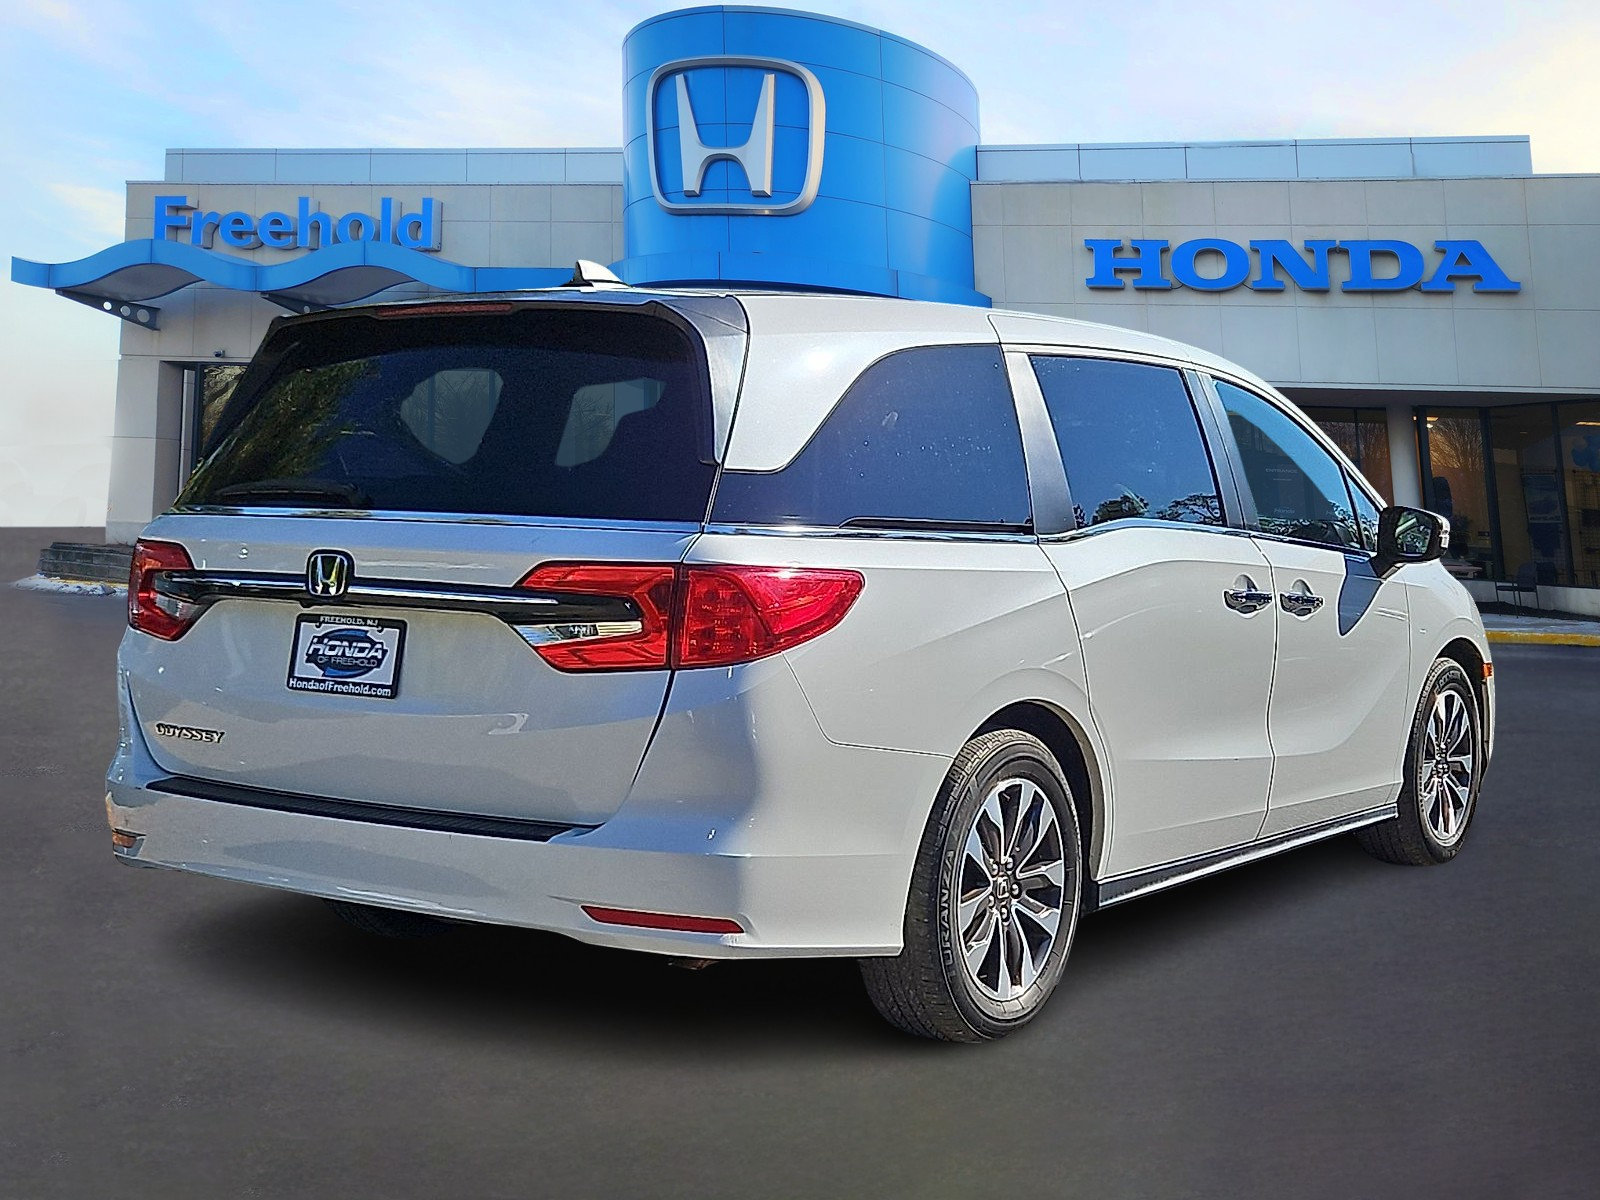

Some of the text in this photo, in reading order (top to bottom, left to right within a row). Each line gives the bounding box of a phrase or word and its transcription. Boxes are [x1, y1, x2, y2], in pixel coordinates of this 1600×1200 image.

[154, 195, 440, 251] Freehold
[1084, 238, 1522, 293] HONDA
[320, 615, 365, 625] FREEHOLD,
[308, 637, 383, 659] HONDA
[317, 656, 377, 667] OF FREEHOLD
[289, 677, 391, 696] HondaofFreehold.com
[155, 722, 226, 743] ODYSSEY
